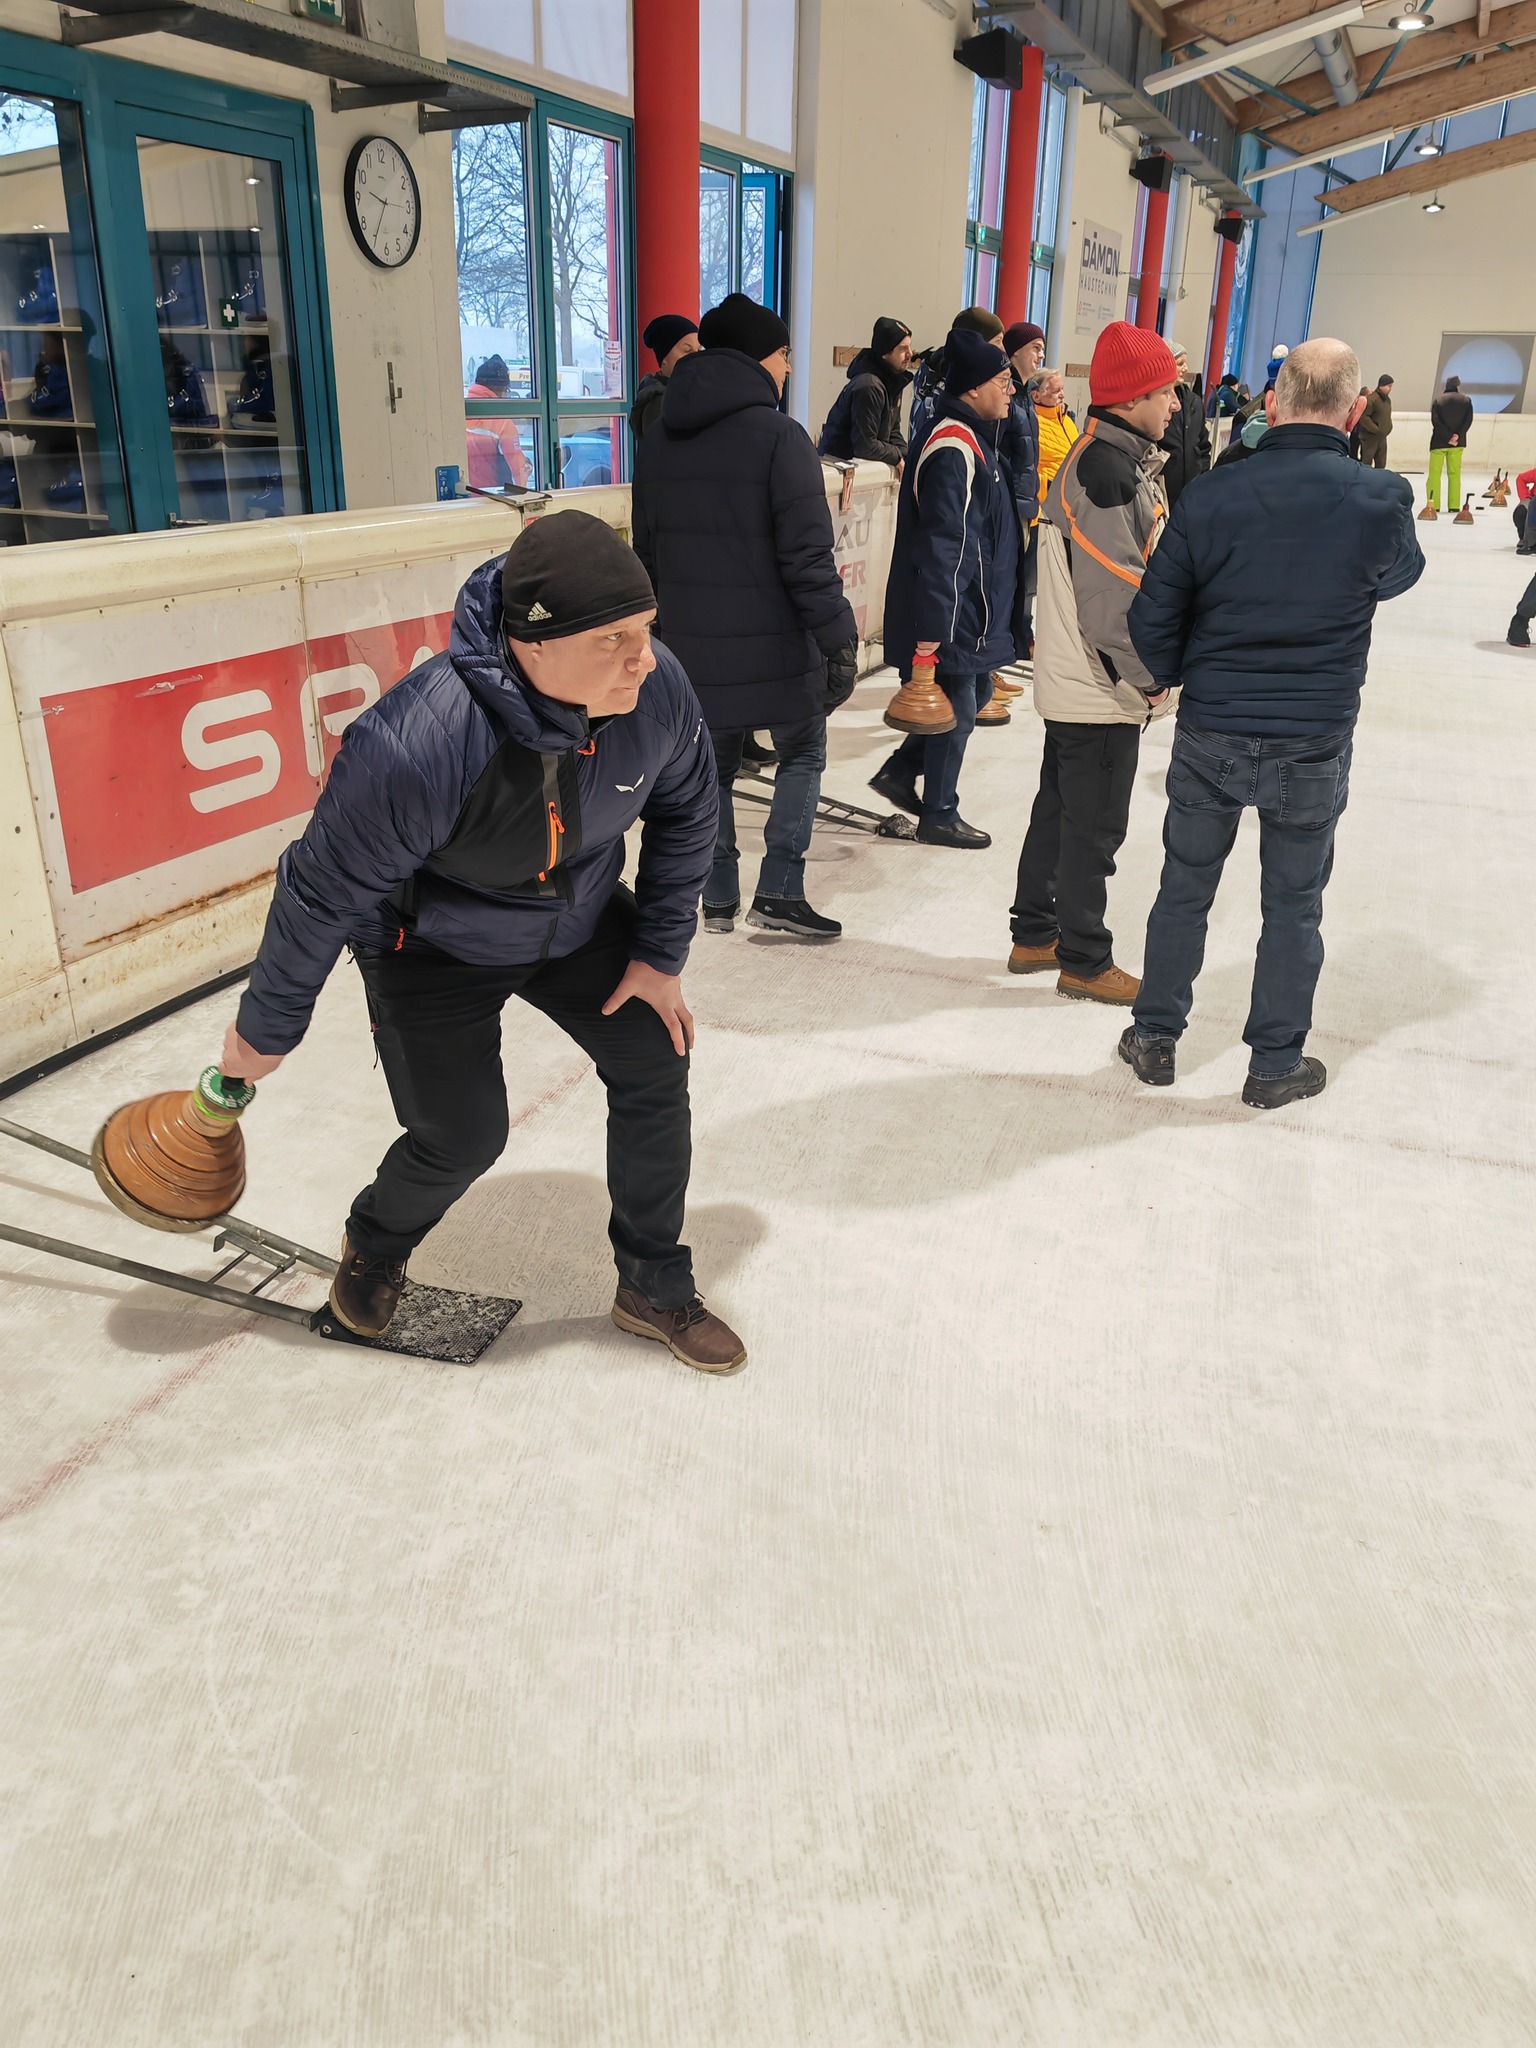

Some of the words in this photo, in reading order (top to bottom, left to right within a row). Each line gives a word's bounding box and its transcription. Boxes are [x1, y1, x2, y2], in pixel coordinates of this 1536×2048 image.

[366, 153, 372, 168] 11
[377, 148, 385, 164] 12
[358, 169, 366, 184] 10
